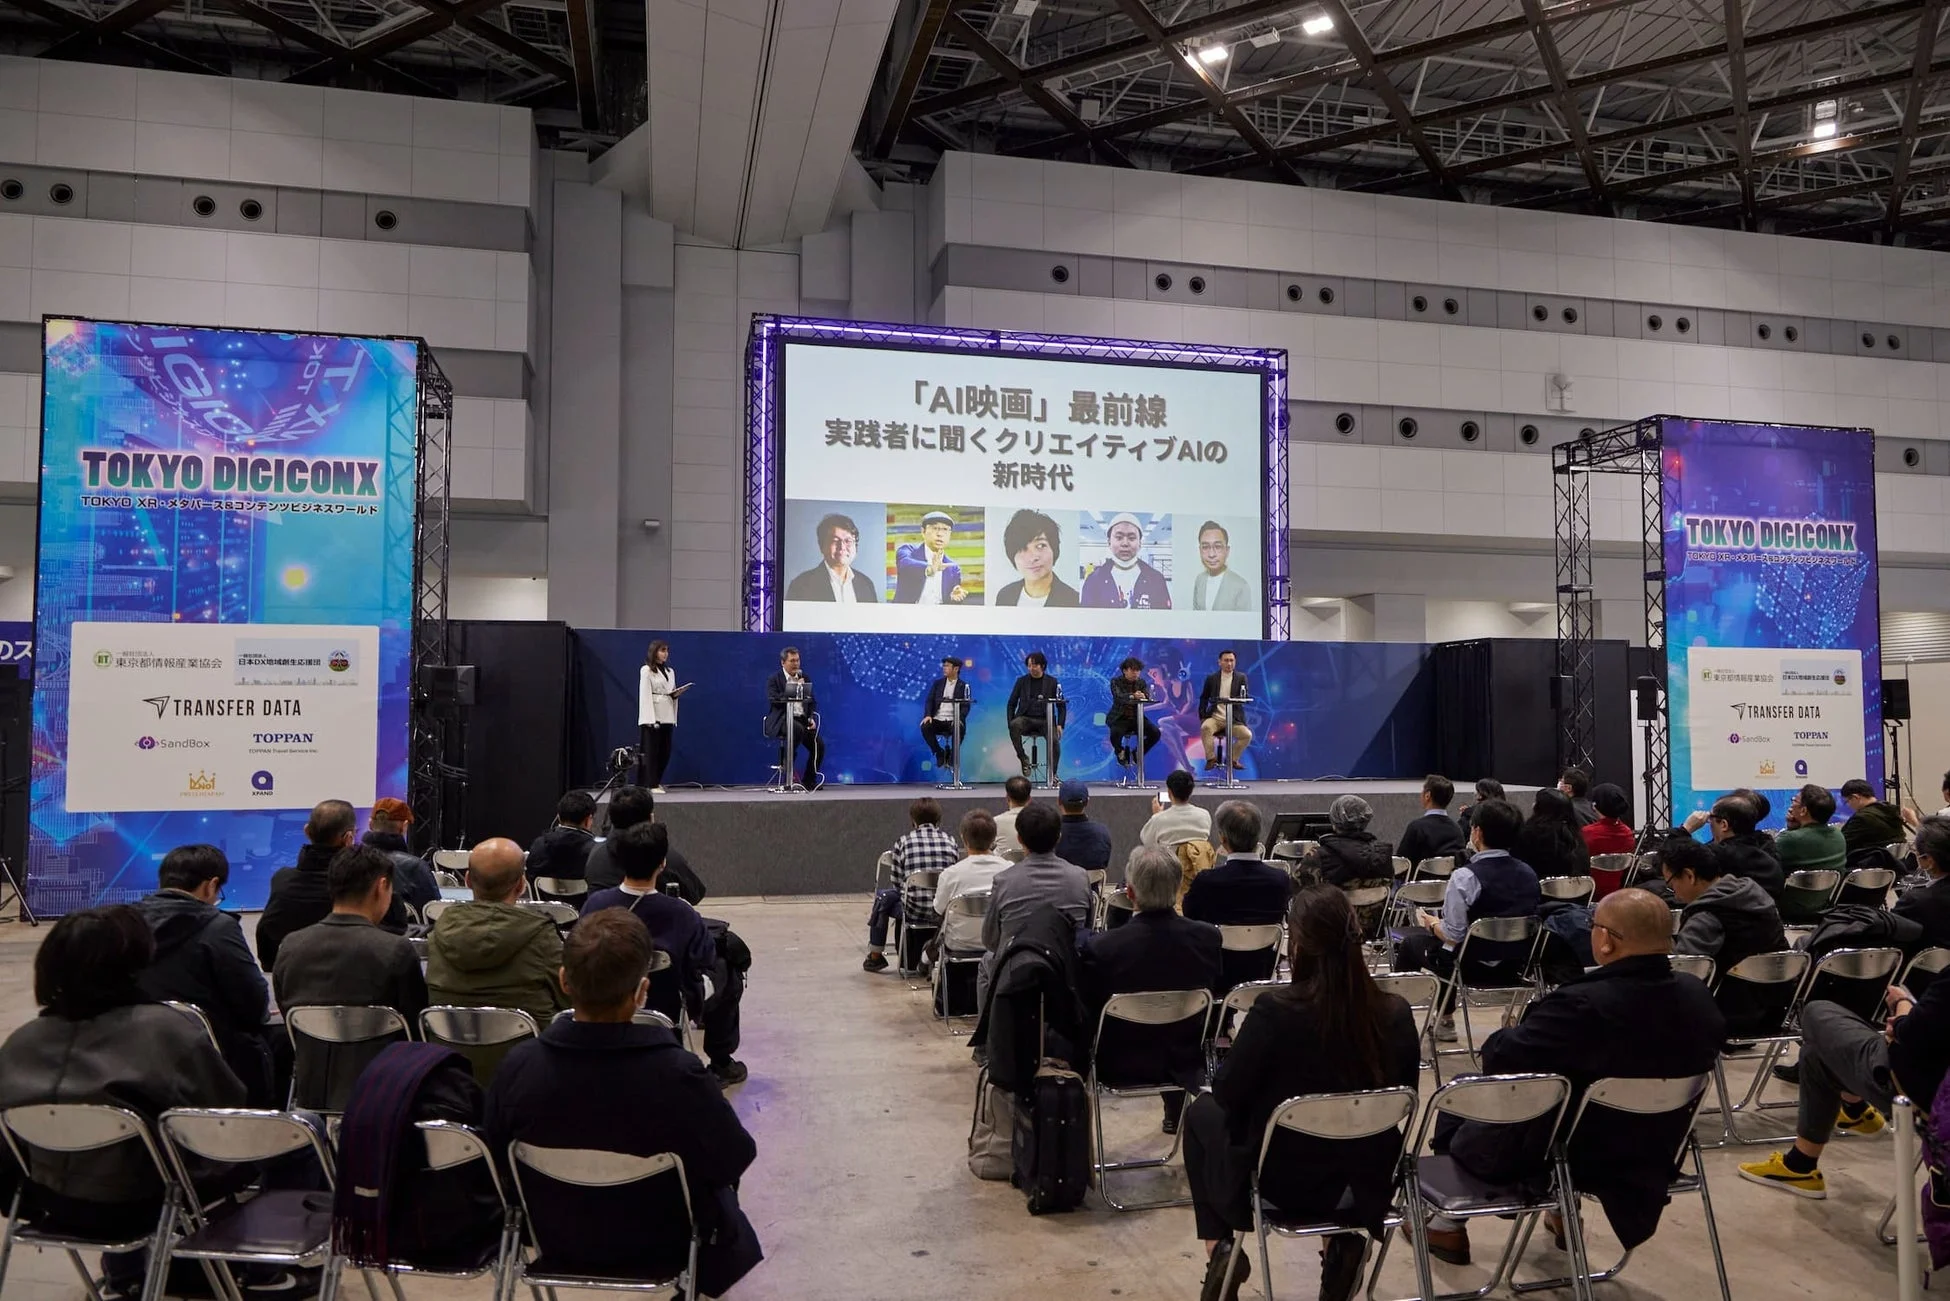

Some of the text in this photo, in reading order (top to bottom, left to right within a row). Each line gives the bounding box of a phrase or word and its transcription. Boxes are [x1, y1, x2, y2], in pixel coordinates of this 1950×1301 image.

[824, 418, 1228, 464] 実践者に聞くクリエイティブAIの
[82, 451, 379, 498] TOKYO DIGICONX
[992, 461, 1075, 492] 新時代
[81, 495, 132, 507] TOKYO
[1686, 518, 1856, 551] TOKYO DIGICONX
[1687, 552, 1716, 561] TOKYO
[115, 657, 223, 669] 東京都情報産業協会
[173, 699, 302, 717] TRANSFER DATA
[1748, 705, 1821, 719] TRANSFER DATA
[253, 732, 314, 744] TOPPAN
[1793, 731, 1829, 740] TOPPAN
[160, 738, 211, 749] SandBox
